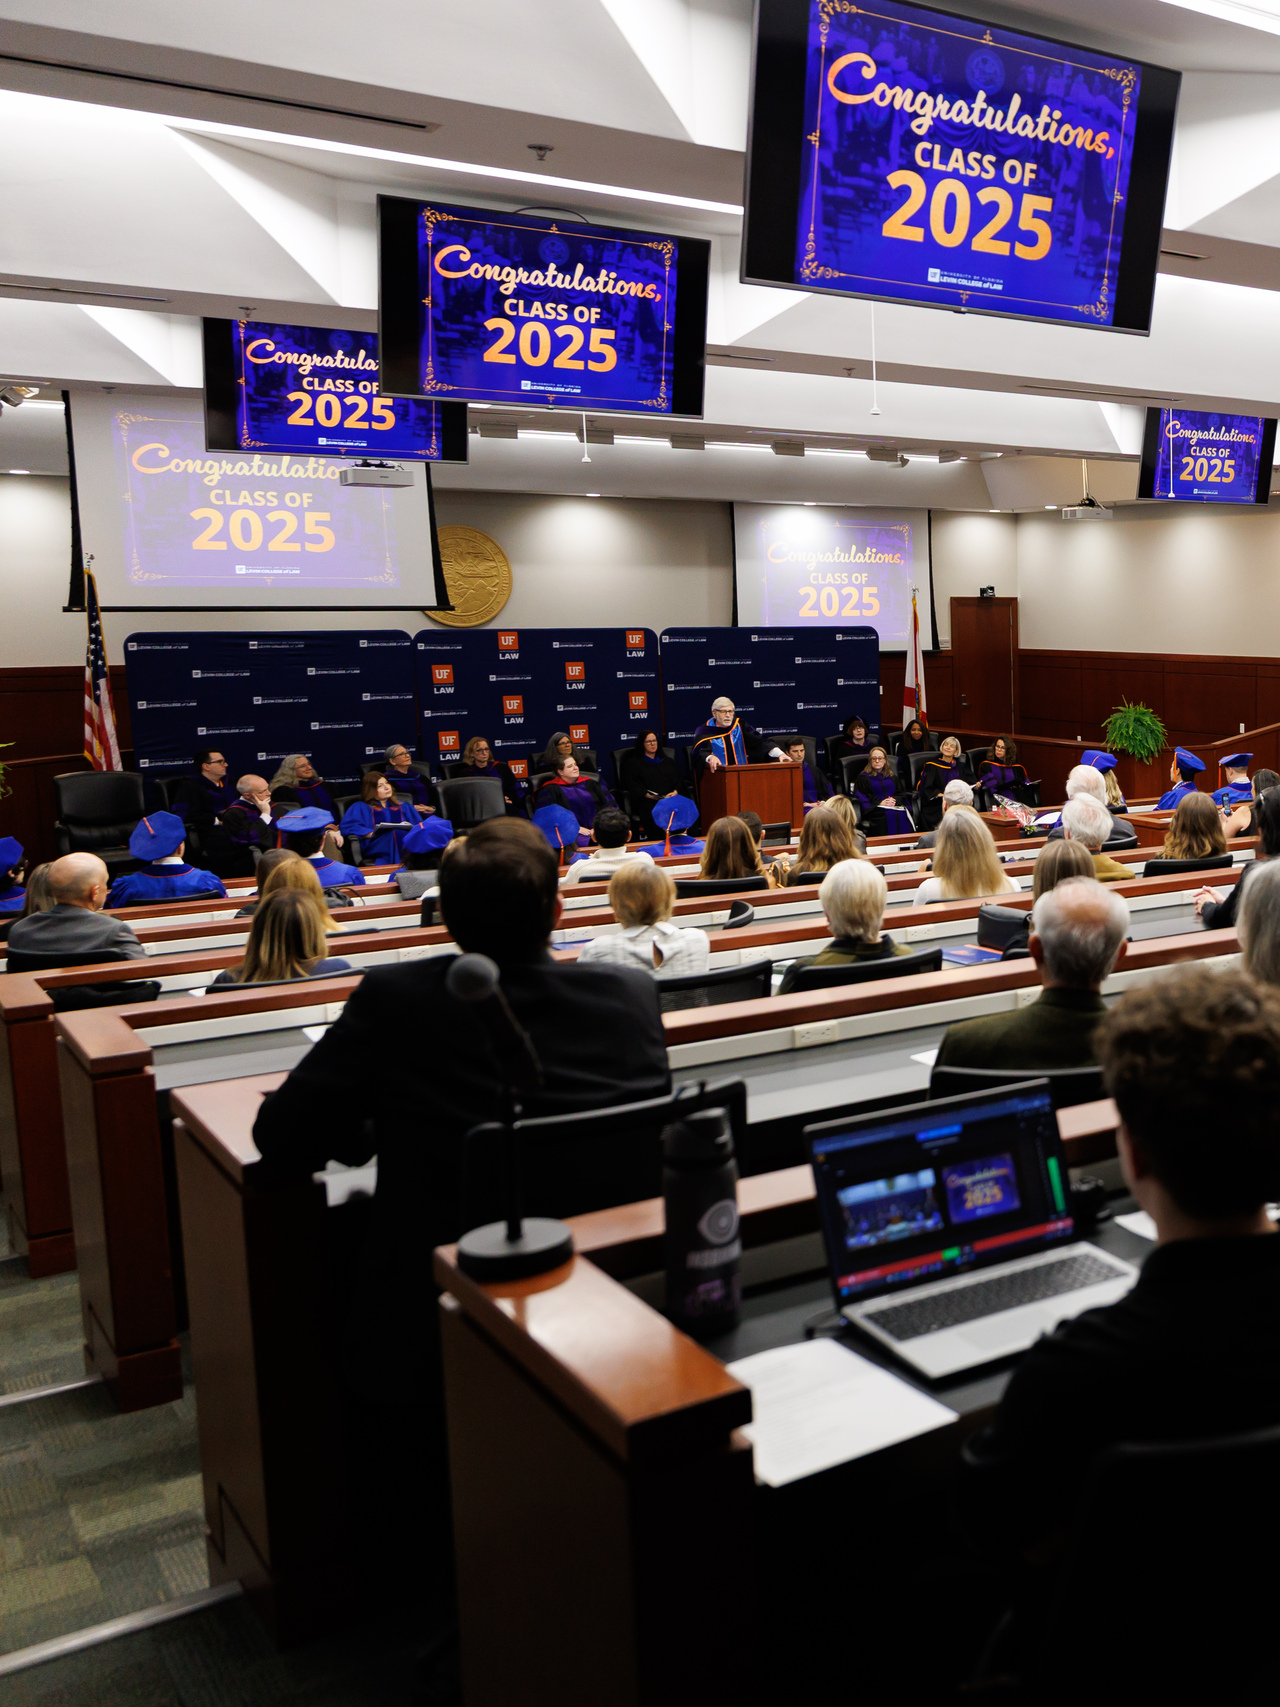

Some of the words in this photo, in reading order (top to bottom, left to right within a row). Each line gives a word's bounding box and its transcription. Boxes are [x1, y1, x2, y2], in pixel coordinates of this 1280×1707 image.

[827, 52, 1115, 159] Congratulations,
[915, 142, 996, 179] CLASS
[1003, 159, 1037, 186] OF
[882, 170, 1053, 260] 2025
[434, 245, 662, 302] Congratulations,
[504, 298, 568, 320] CLASS
[574, 306, 601, 324] OF
[246, 338, 379, 375] Congratula
[483, 318, 617, 372] 2025
[302, 377, 354, 393] CLASS
[358, 381, 379, 394] OF
[286, 391, 395, 430] 2025
[1165, 421, 1256, 445] Congratulations,
[1190, 446, 1217, 457] CLASS
[1218, 448, 1230, 458] OF
[131, 443, 341, 486] Congratulatio
[1180, 456, 1235, 483] 2025
[209, 489, 278, 506] CLASS
[284, 491, 313, 508] OF
[189, 507, 336, 552] 2025
[767, 541, 904, 570] Congratulations,
[810, 572, 848, 584] CLASS
[852, 572, 868, 584] OF
[798, 586, 880, 617] 2025
[500, 636, 515, 645] UF
[629, 635, 642, 643] UF
[435, 669, 450, 679] UF
[568, 666, 582, 675] UF
[506, 700, 520, 709] UF
[632, 696, 644, 705] UF
[442, 736, 456, 745] UF
[572, 729, 586, 739] UF
[511, 764, 525, 774] UF
